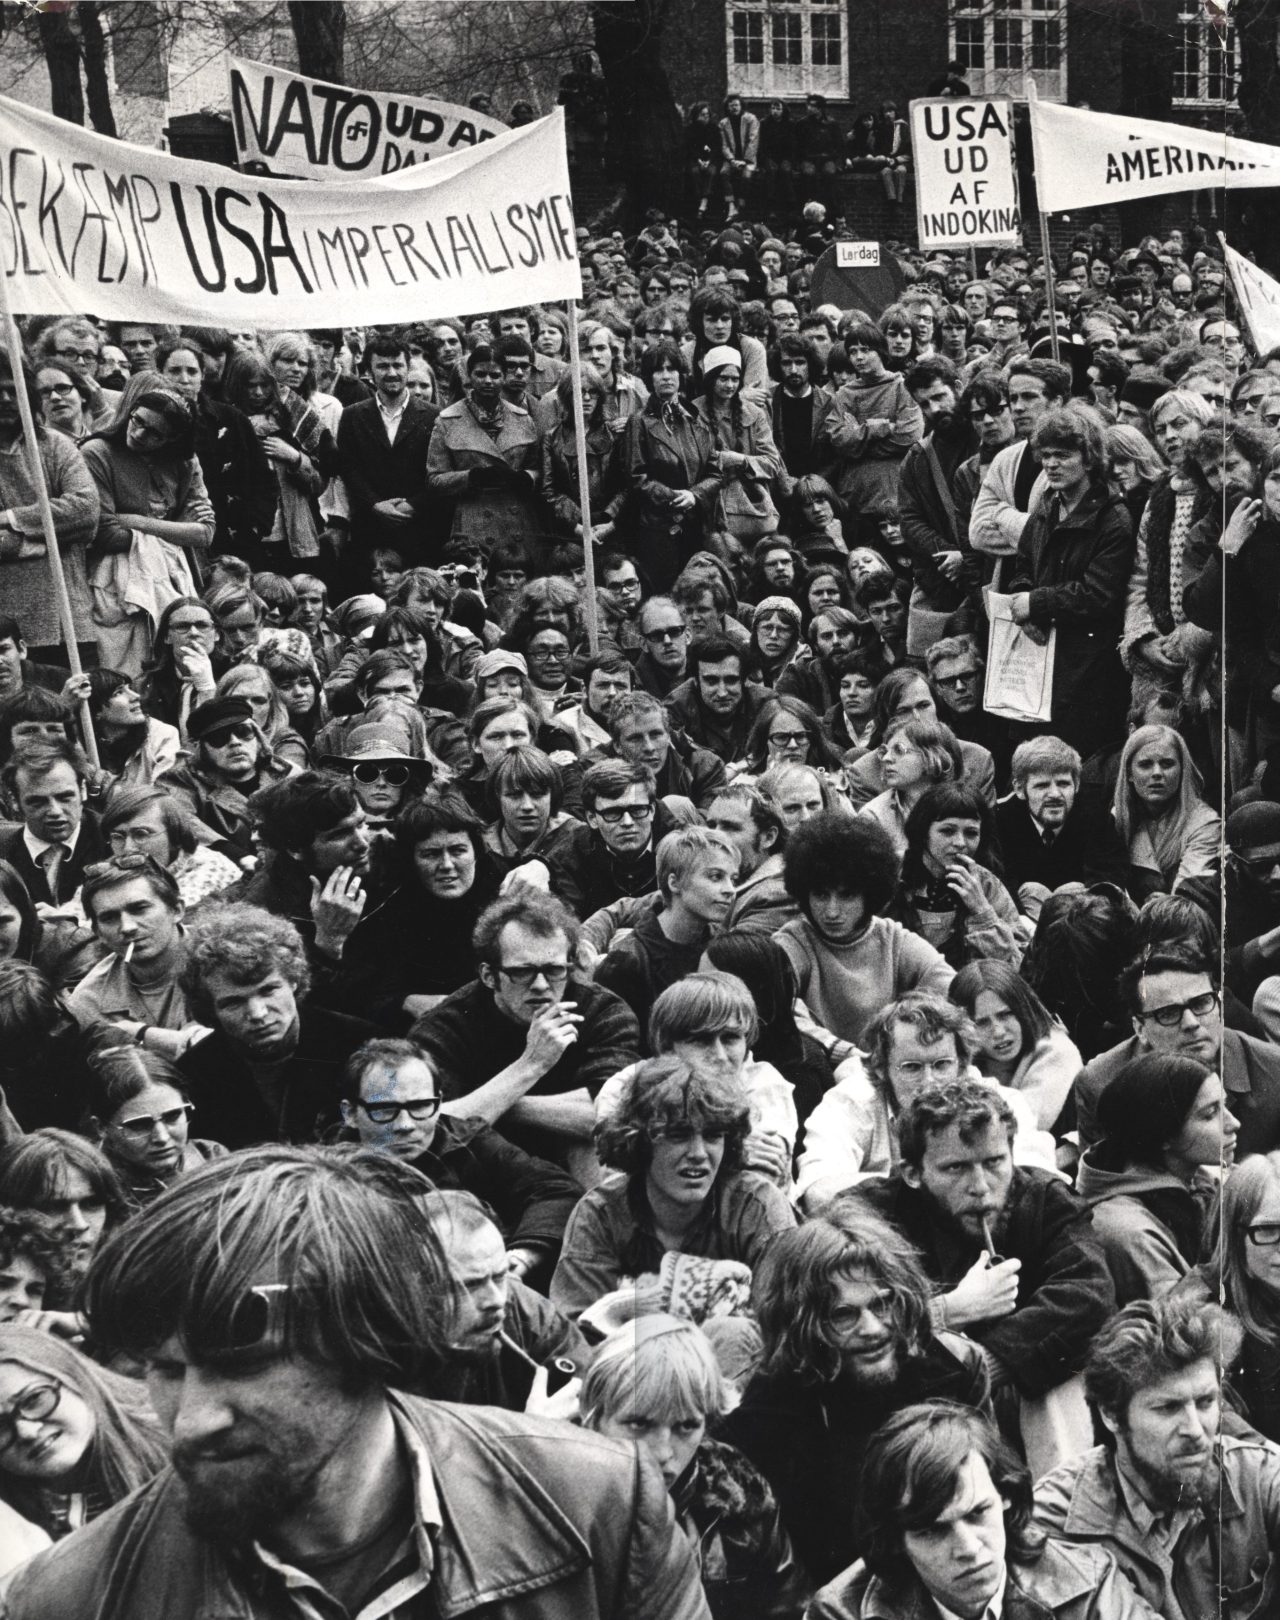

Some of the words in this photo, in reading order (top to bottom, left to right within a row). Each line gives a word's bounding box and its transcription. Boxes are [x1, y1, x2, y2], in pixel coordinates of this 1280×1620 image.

[230, 69, 382, 171] NATO
[386, 101, 444, 144] UD
[924, 103, 1007, 141] USA
[944, 146, 988, 174] UD
[950, 180, 989, 205] AF
[169, 181, 314, 295] USA
[923, 208, 1022, 238] INDOKINA
